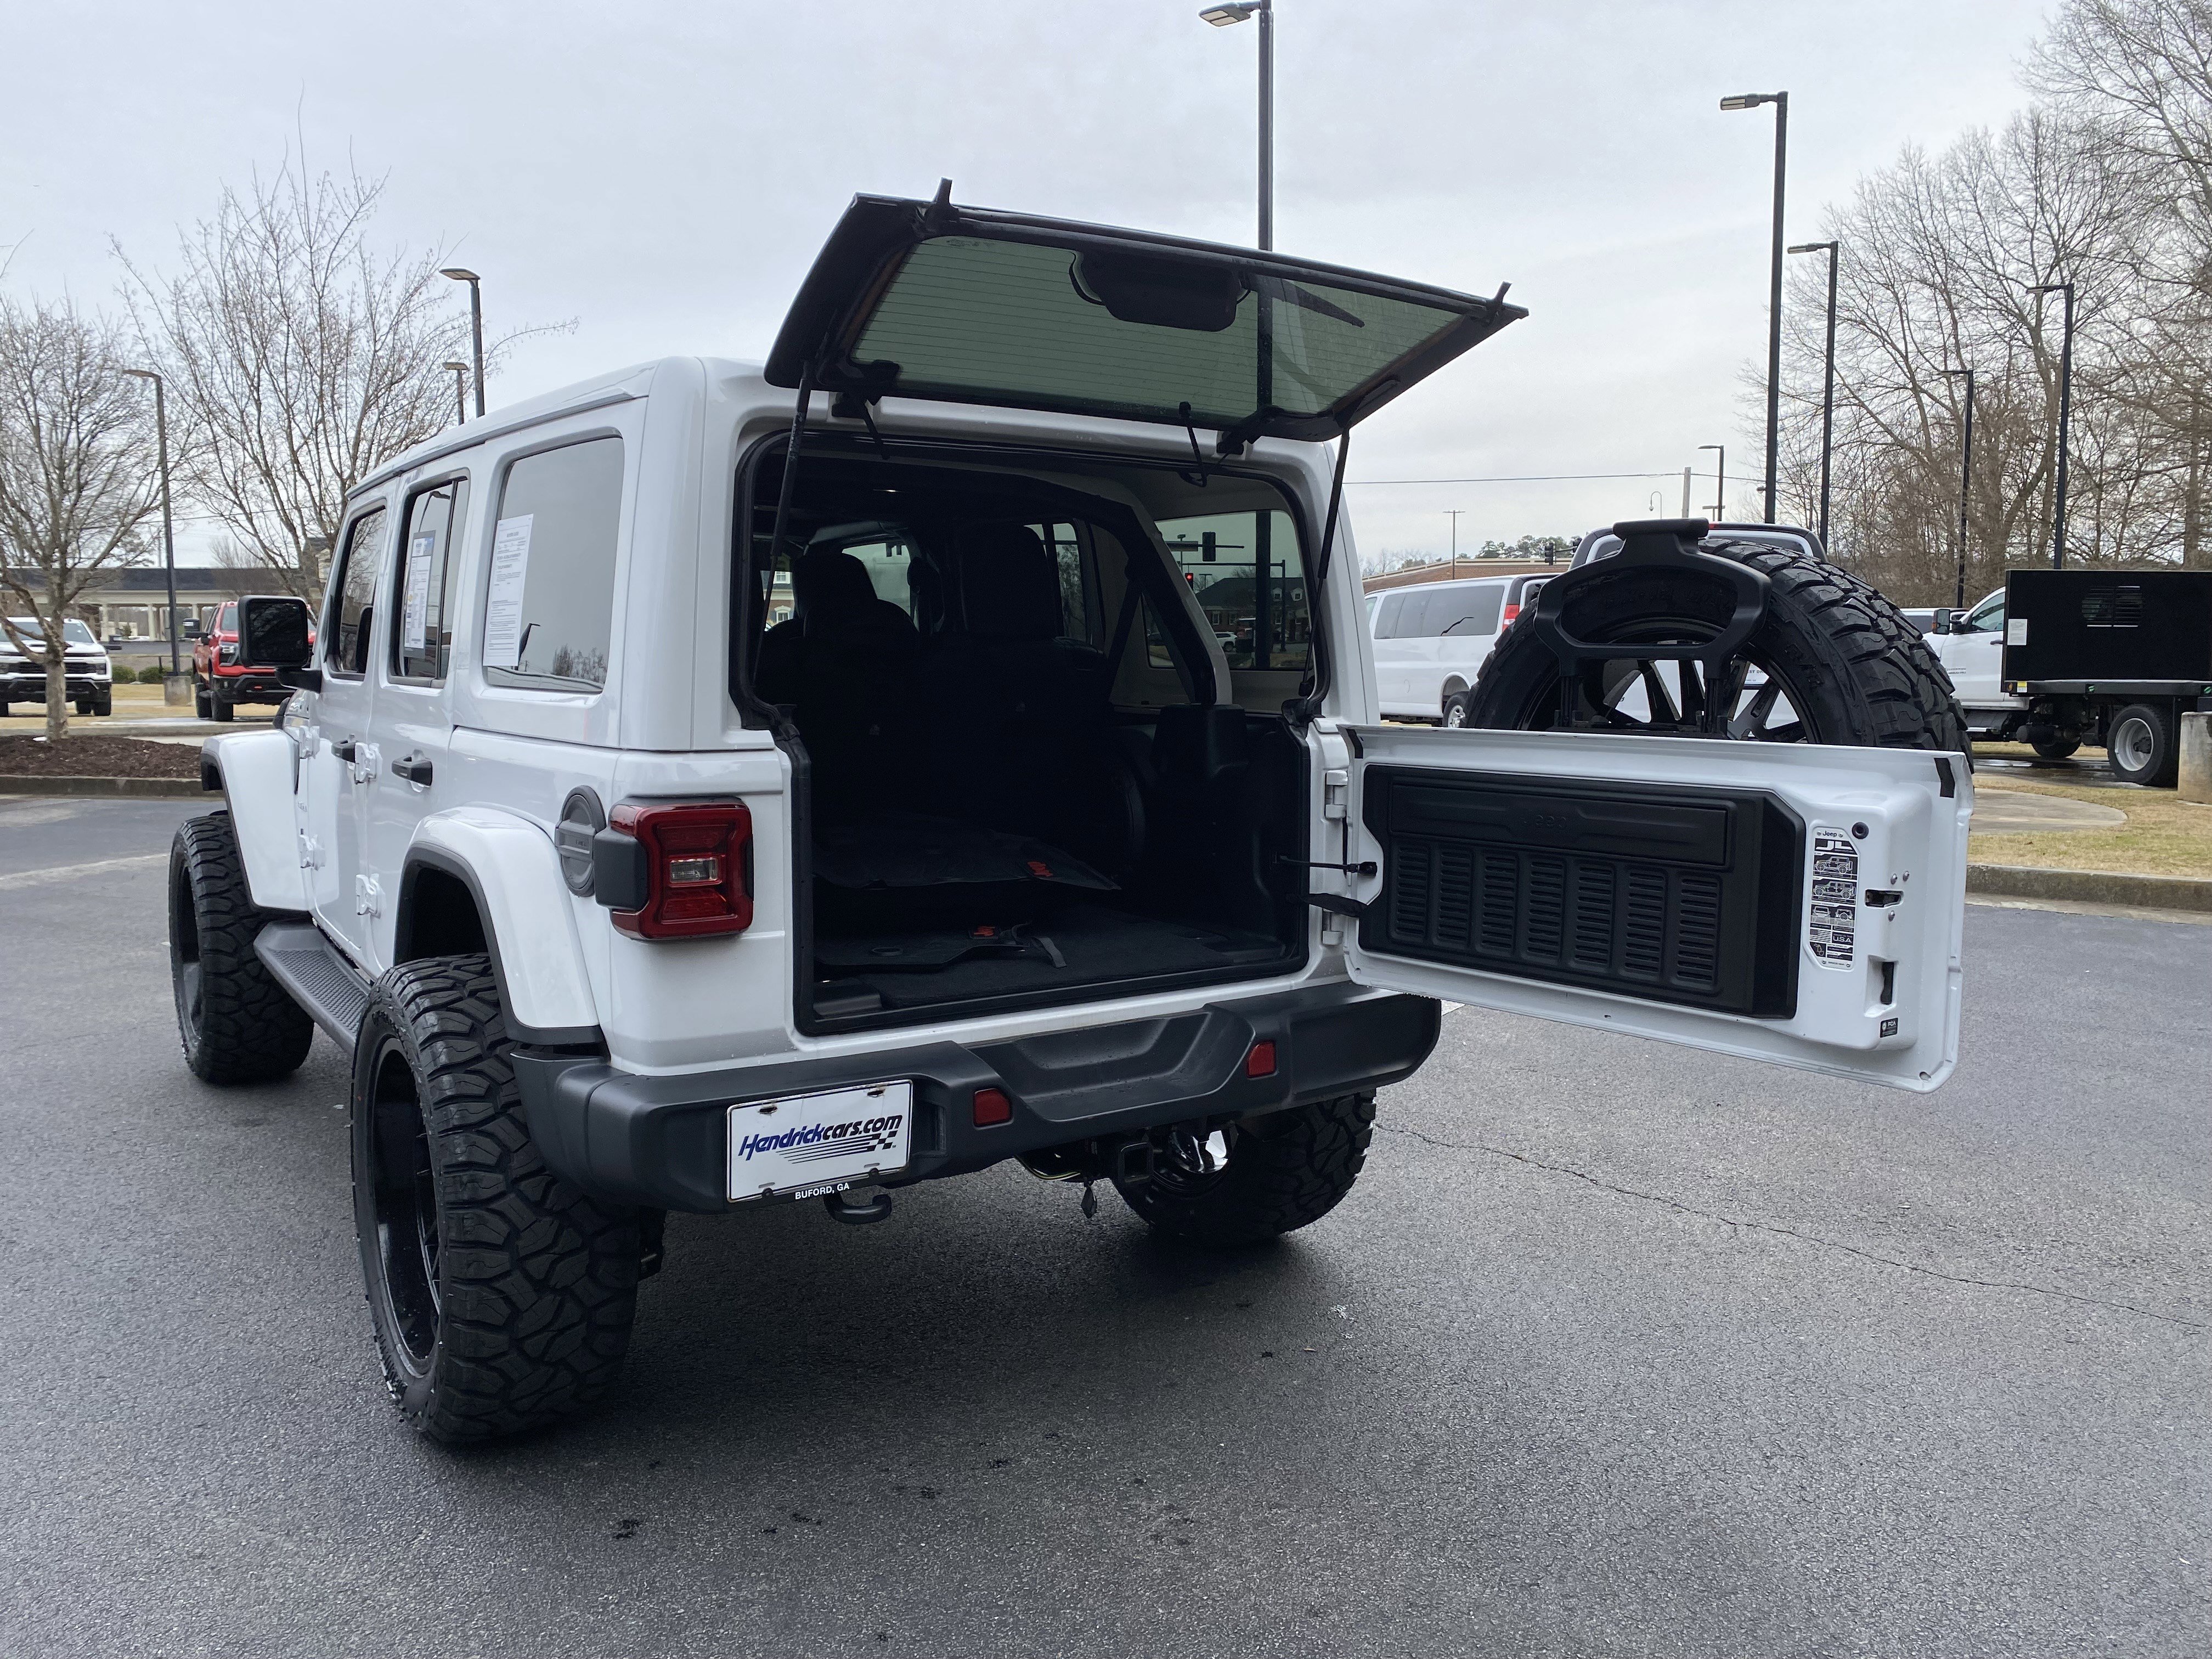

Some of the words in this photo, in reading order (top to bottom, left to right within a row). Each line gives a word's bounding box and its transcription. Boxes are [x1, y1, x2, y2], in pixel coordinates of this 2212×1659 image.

[1815, 840, 1853, 851] JL
[738, 1114, 903, 1161] Hendrickcars.com
[795, 1186, 834, 1200] BUFORD,
[837, 1182, 850, 1192] GA
